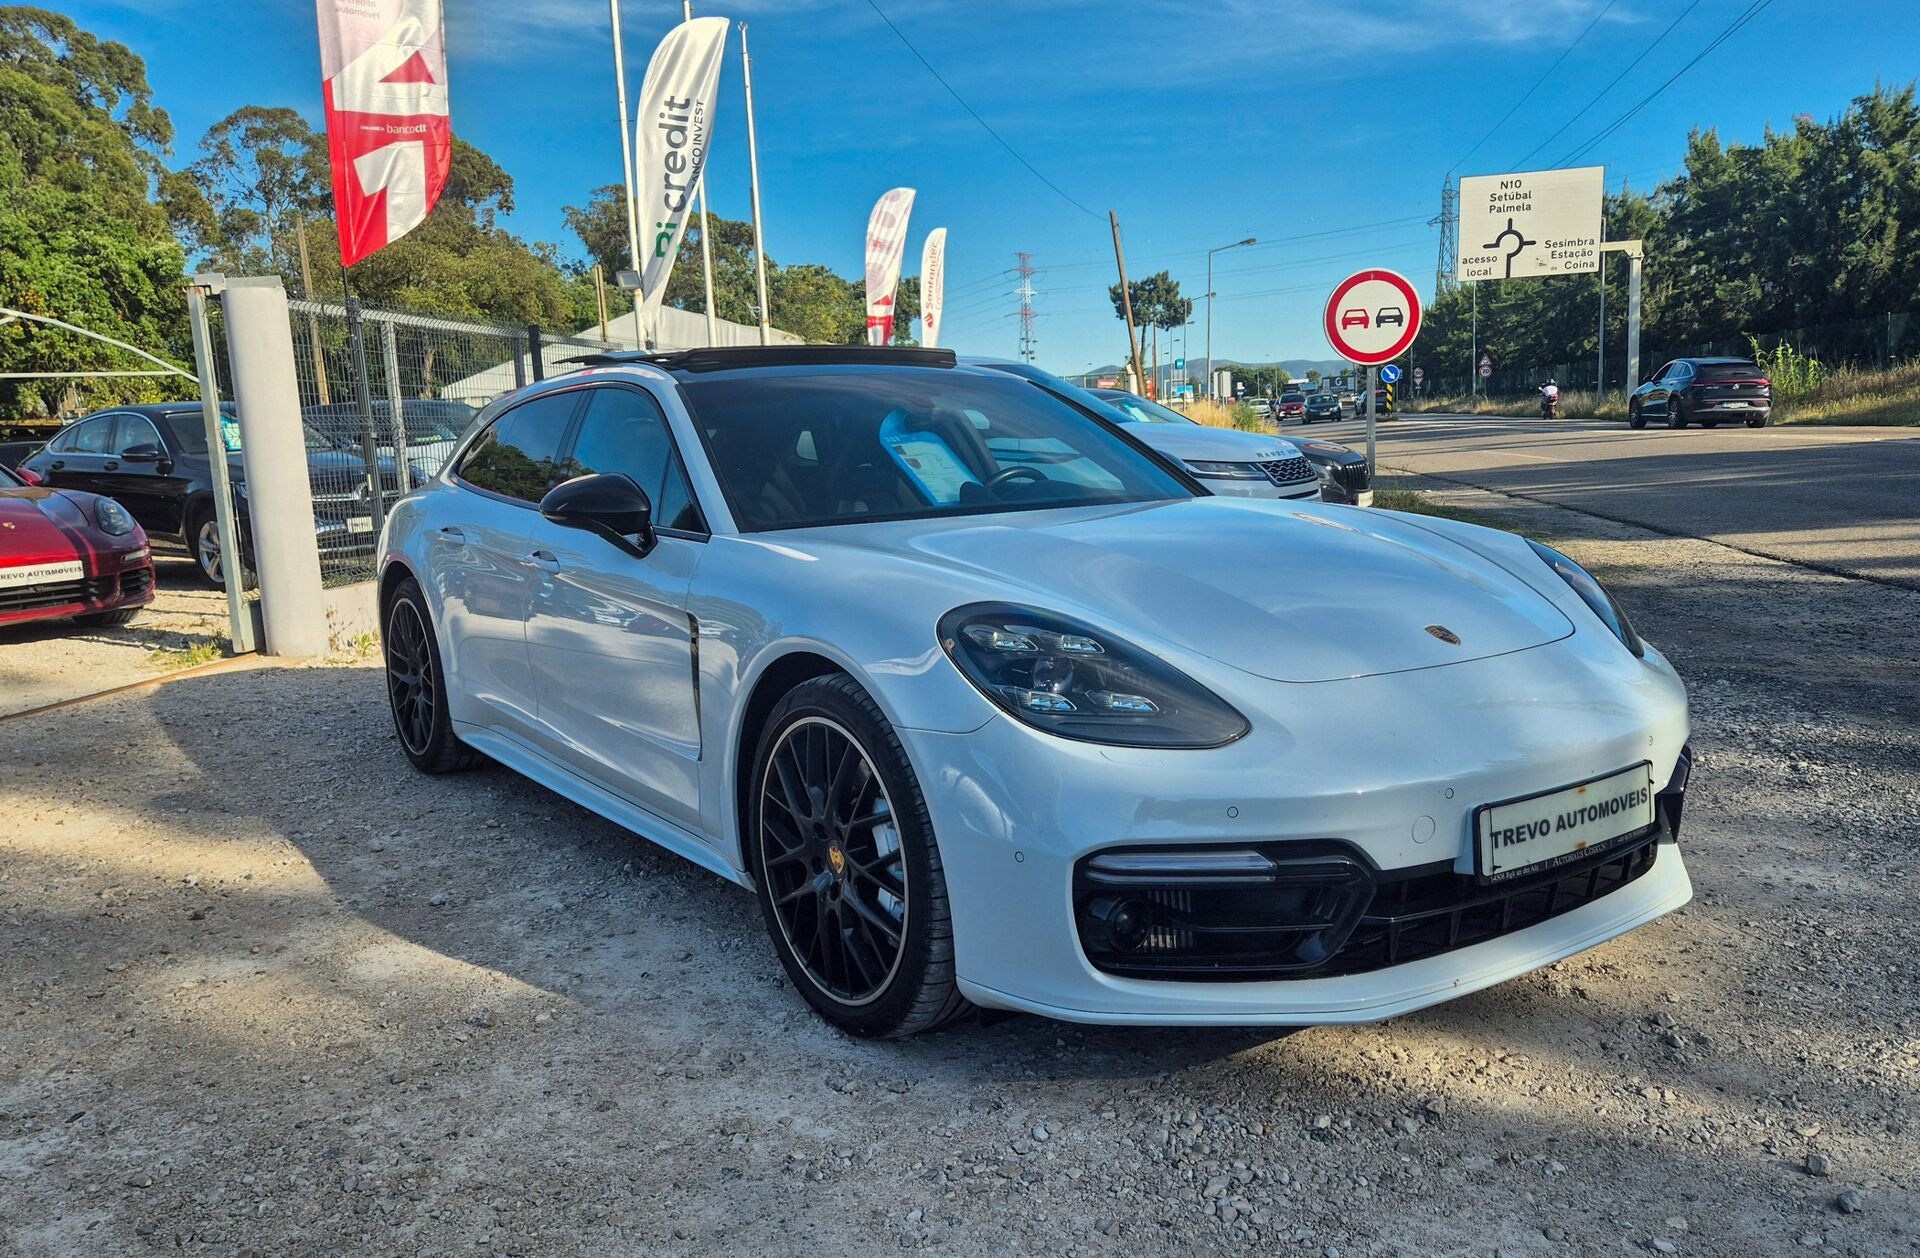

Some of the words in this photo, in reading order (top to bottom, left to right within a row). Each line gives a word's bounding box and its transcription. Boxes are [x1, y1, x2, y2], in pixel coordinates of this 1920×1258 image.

[693, 99, 705, 146] INVEST
[386, 124, 427, 134] bancoctt
[659, 95, 691, 213] credit
[1500, 179, 1522, 190] N10
[1489, 190, 1532, 202] Setúbal
[1489, 203, 1532, 214] Palmela
[1544, 238, 1595, 249] Sesimbra
[1462, 255, 1498, 264] acesso
[1551, 249, 1593, 260] Estação
[1564, 260, 1595, 270] Coina
[926, 243, 938, 310] Santander
[1466, 267, 1492, 277] local
[0, 572, 24, 580] REVO
[27, 566, 82, 577] AUTOMOVEIS
[1490, 818, 1551, 849] TREVO
[1555, 787, 1649, 833] AUTOMOVEIS
